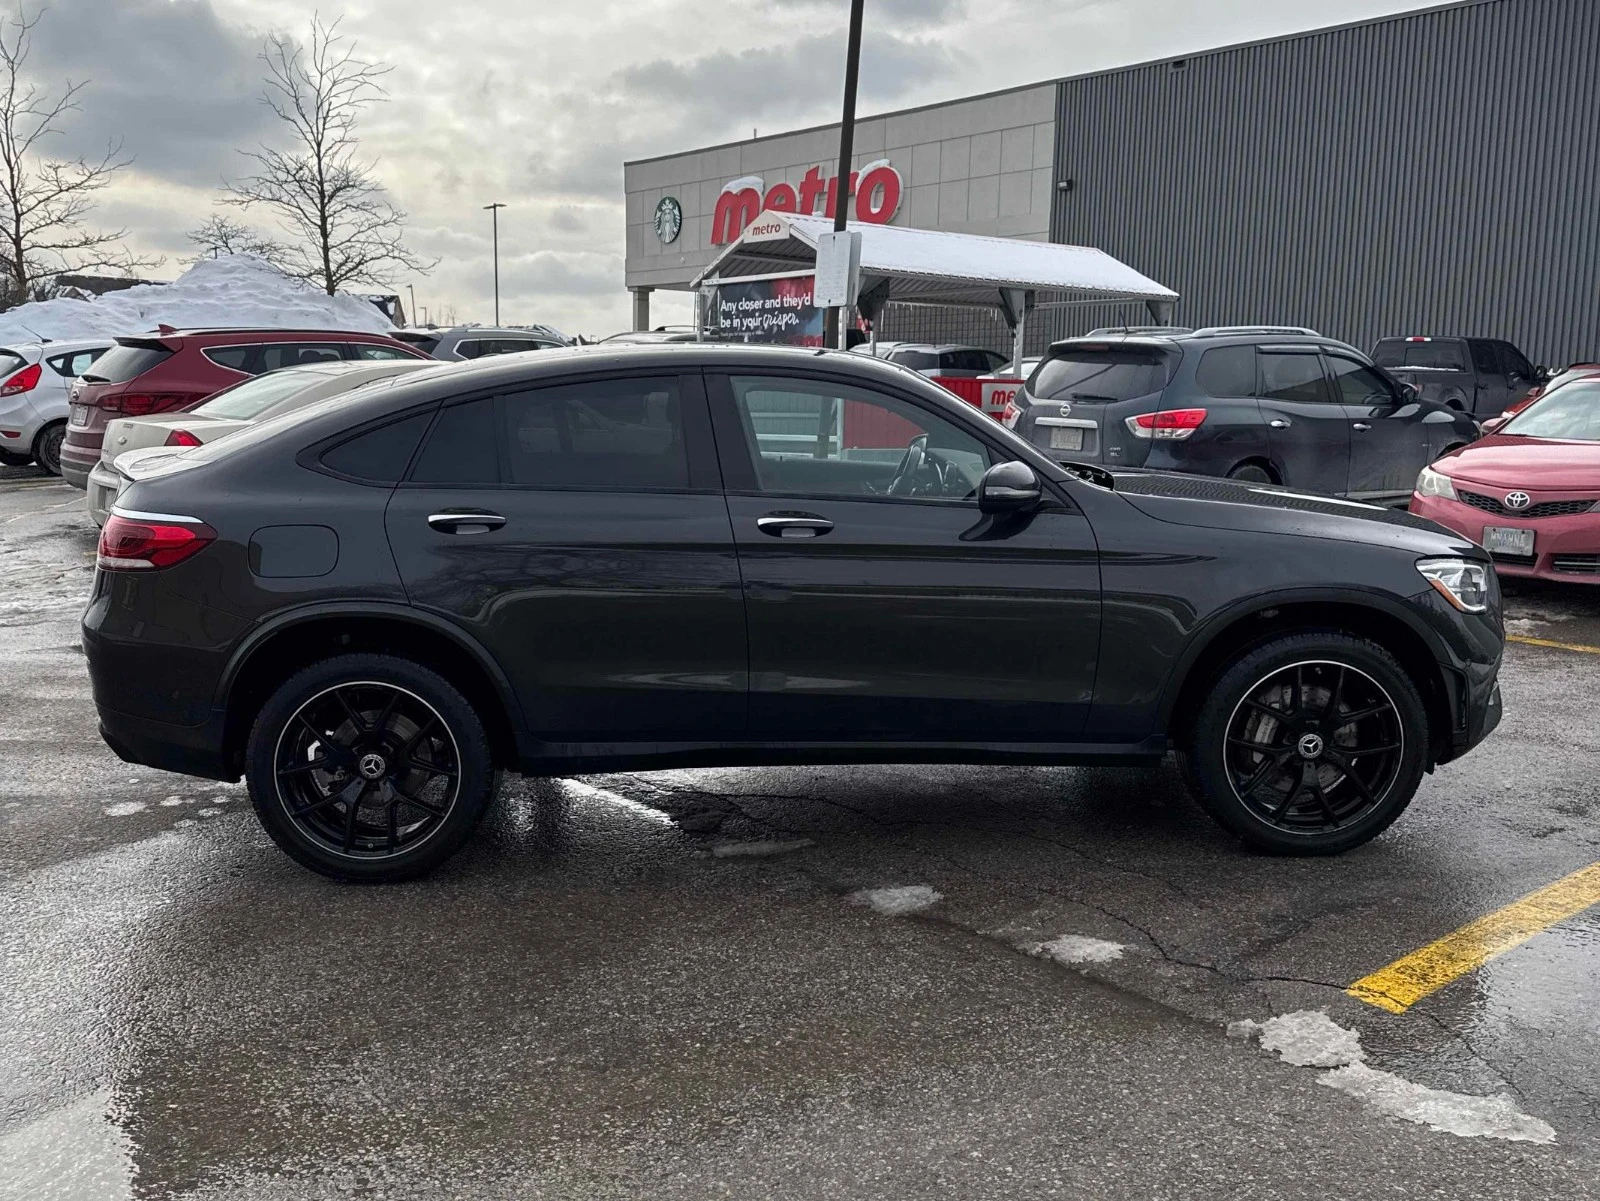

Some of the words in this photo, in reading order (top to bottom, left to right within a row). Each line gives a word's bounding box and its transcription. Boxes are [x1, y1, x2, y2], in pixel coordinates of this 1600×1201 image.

[711, 165, 902, 245] metro
[752, 223, 781, 236] metro
[720, 299, 737, 314] Any
[738, 297, 763, 310] closer
[764, 294, 781, 308] and
[783, 291, 811, 309] they'd
[720, 315, 731, 328] be
[732, 315, 741, 328] in
[742, 317, 763, 330] your
[991, 390, 1016, 405] me
